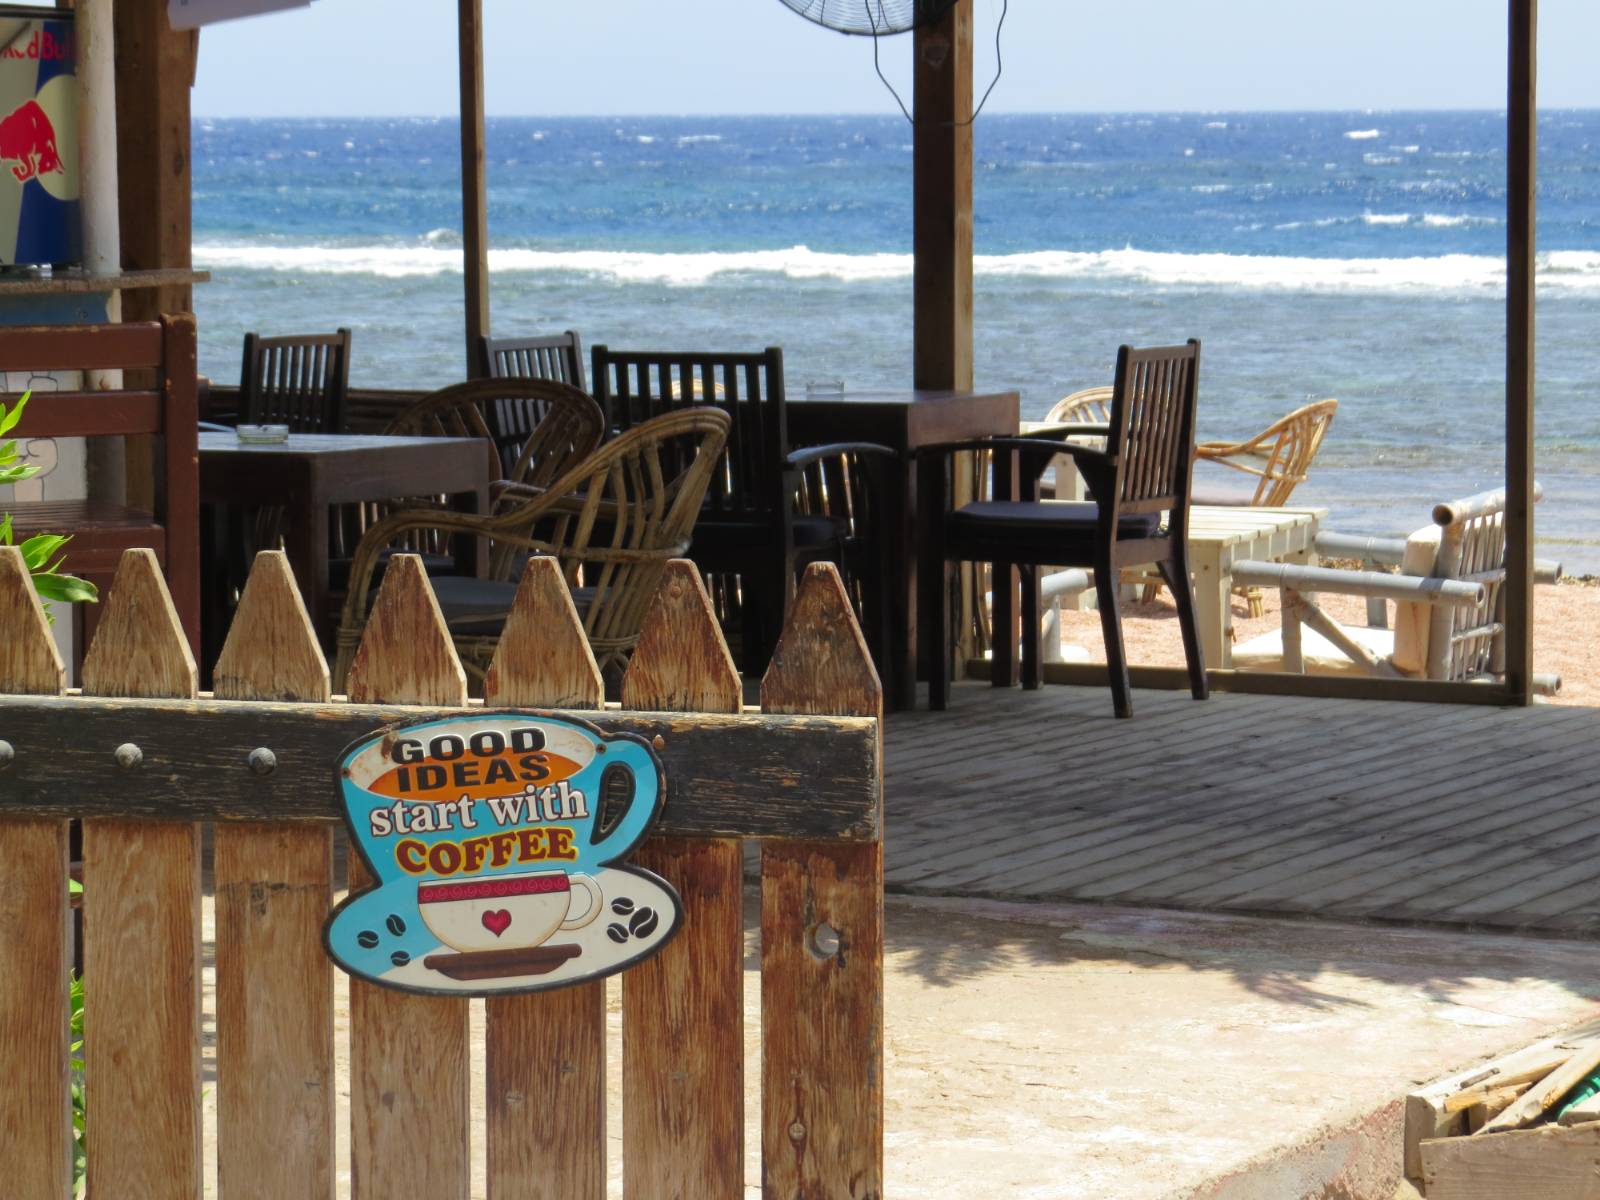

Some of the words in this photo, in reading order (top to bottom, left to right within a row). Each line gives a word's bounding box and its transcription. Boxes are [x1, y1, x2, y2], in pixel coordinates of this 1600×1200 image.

[391, 728, 547, 764] GOOD
[397, 755, 550, 792] IDEAS
[369, 794, 477, 837] start
[488, 780, 589, 825] with
[395, 828, 579, 874] COFFEE
